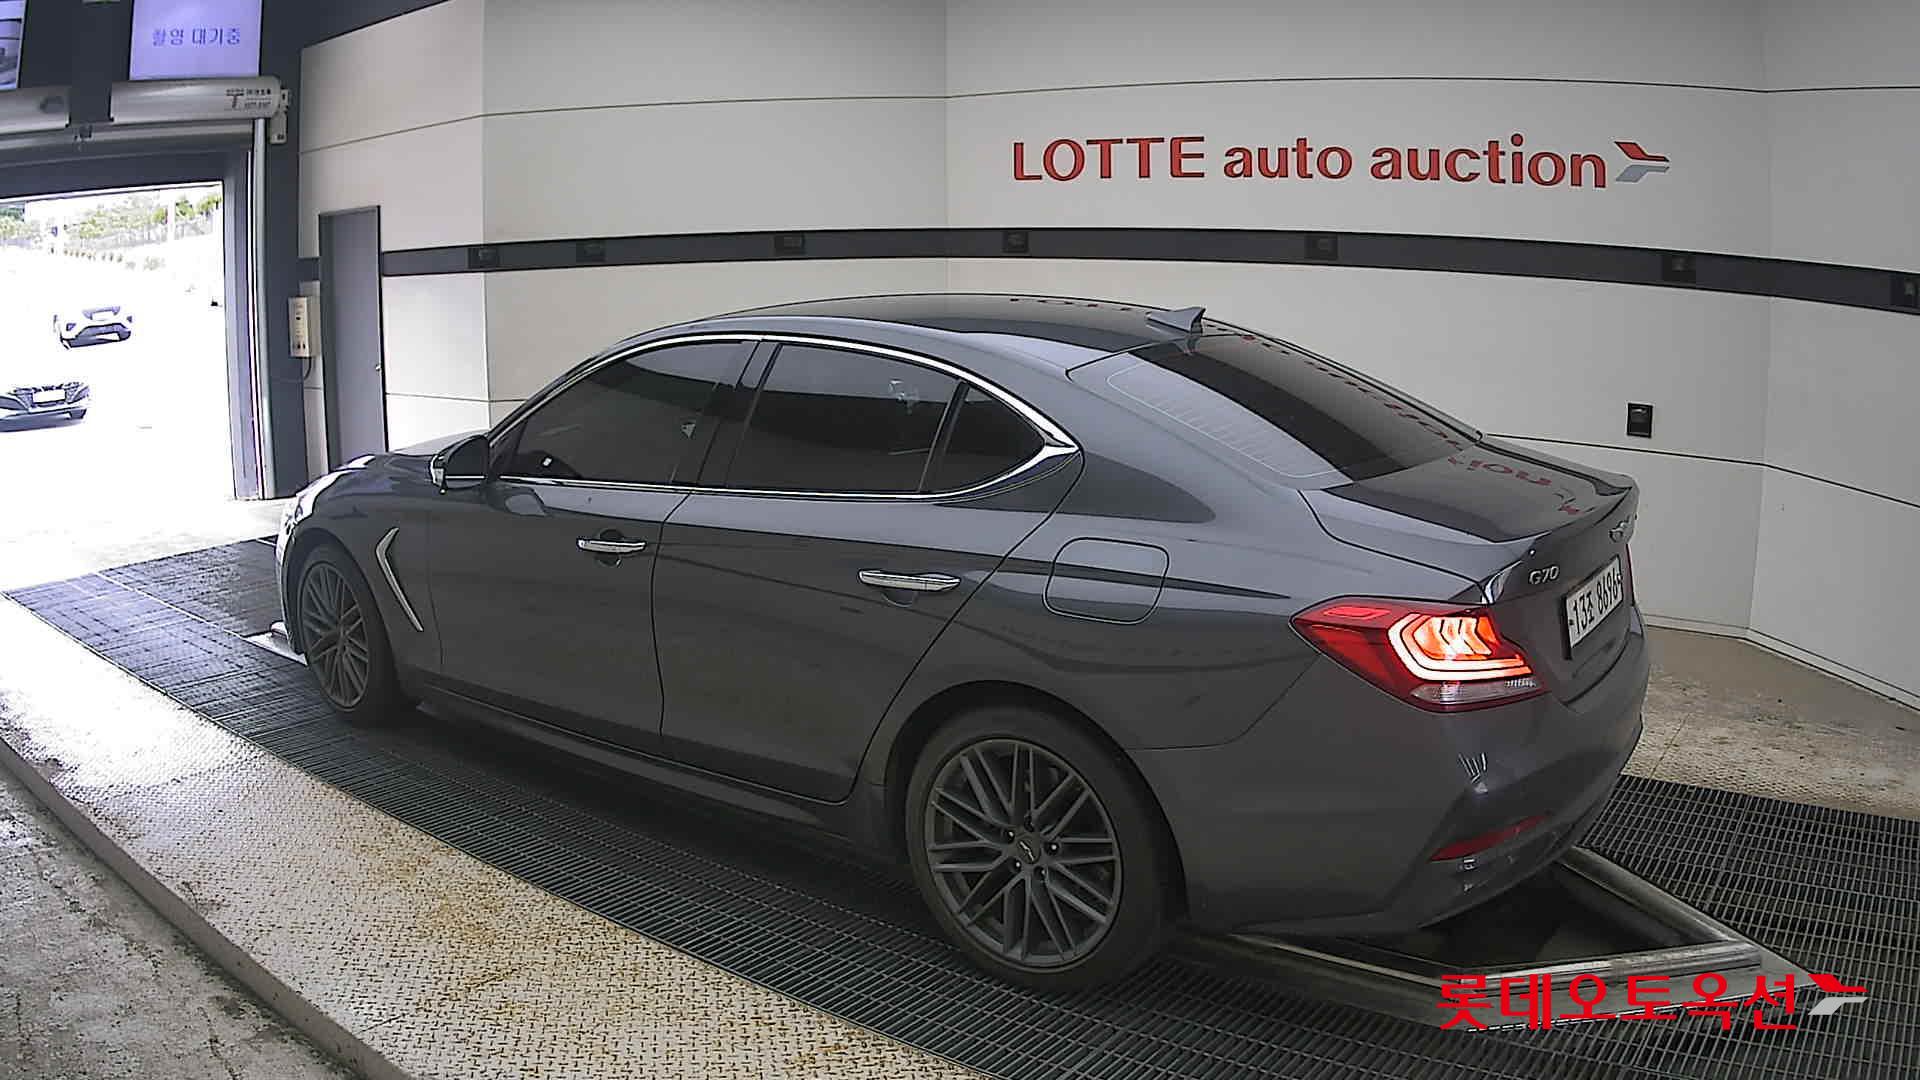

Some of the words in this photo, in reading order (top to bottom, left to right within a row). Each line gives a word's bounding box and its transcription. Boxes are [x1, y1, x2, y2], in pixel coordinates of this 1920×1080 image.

[192, 28, 240, 46] 대기중
[1013, 136, 1206, 183] LOTTE
[1224, 138, 1354, 181] auto
[1370, 133, 1607, 188] auction
[1529, 565, 1560, 585] G70
